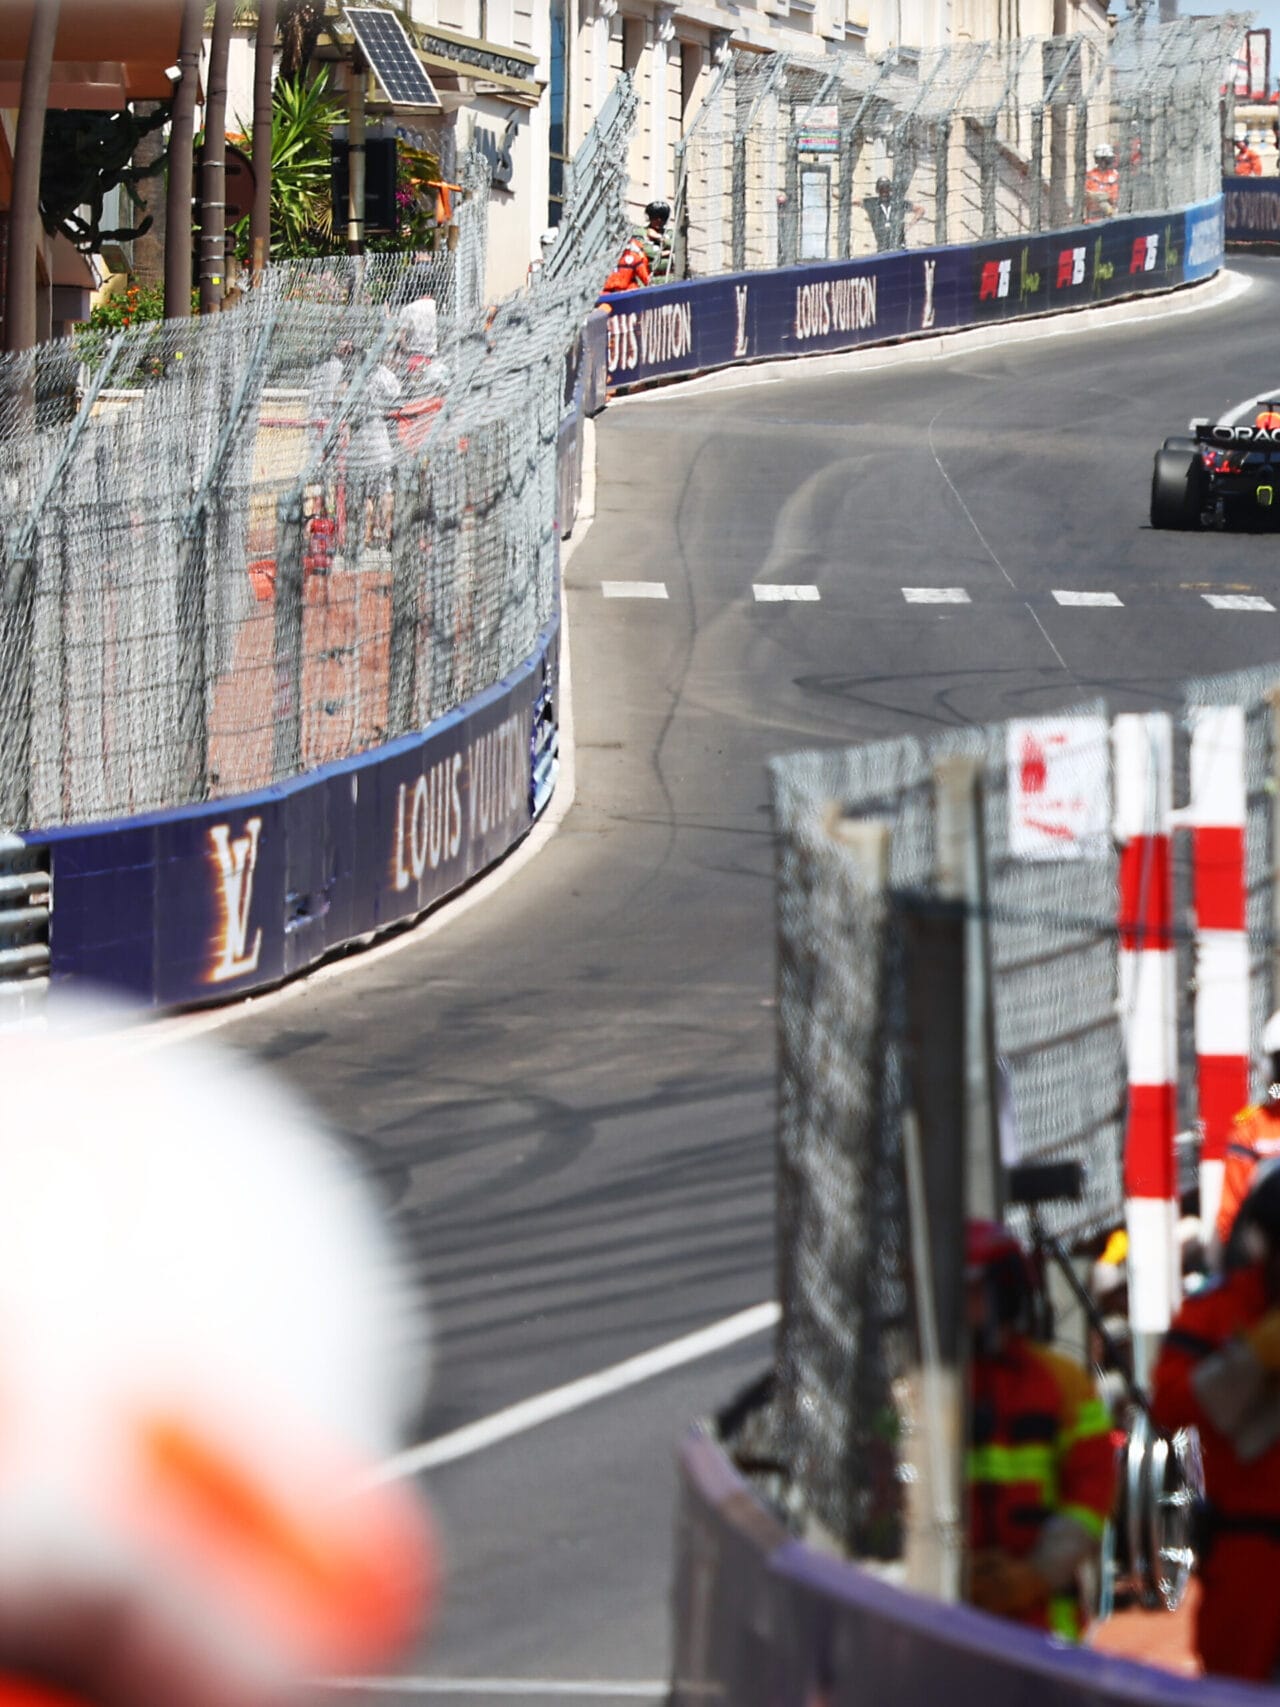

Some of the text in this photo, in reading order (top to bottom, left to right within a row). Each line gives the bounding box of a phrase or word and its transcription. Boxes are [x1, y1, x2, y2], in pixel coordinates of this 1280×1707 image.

[607, 301, 692, 372] UIS VUITTON
[796, 275, 877, 340] LOUIS VUITTON
[394, 752, 462, 892] LOUIS
